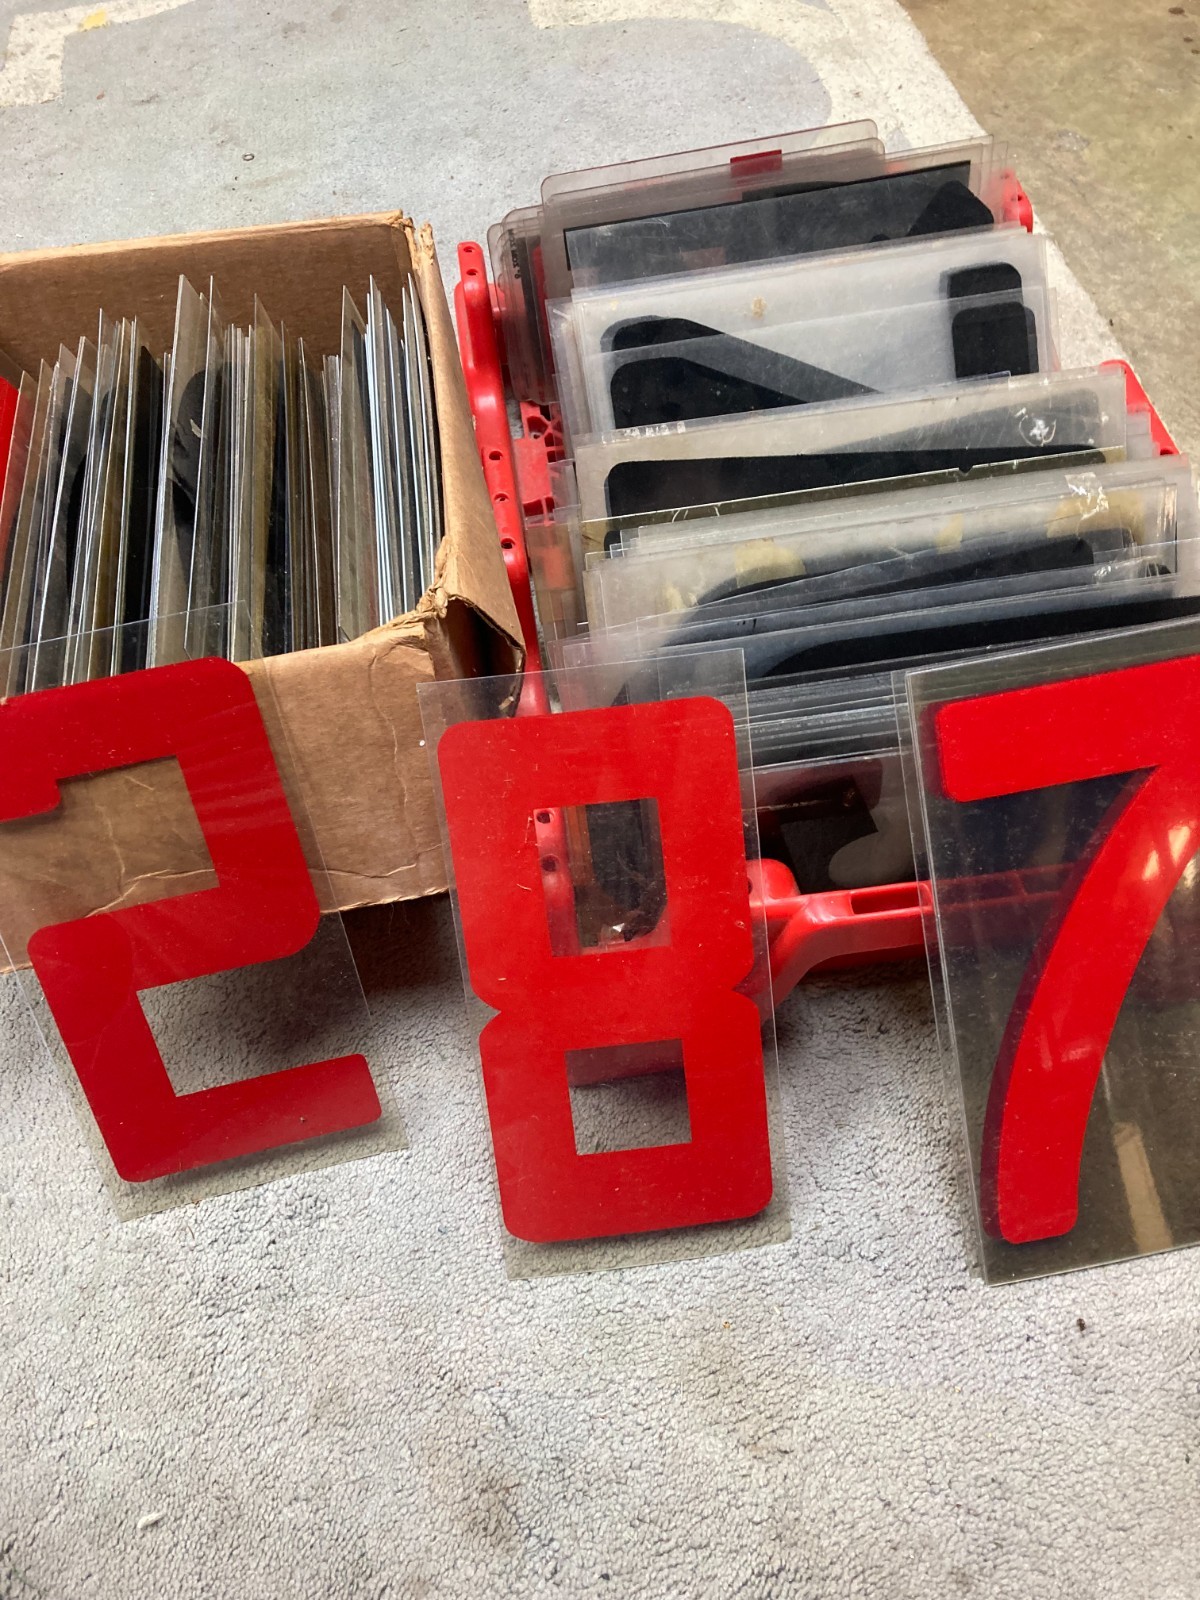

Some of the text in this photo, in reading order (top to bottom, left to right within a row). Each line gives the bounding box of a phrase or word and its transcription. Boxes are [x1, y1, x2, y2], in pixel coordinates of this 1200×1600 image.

[0, 657, 382, 1183] 2
[437, 696, 774, 1244] 8
[934, 653, 1200, 1245] 7
